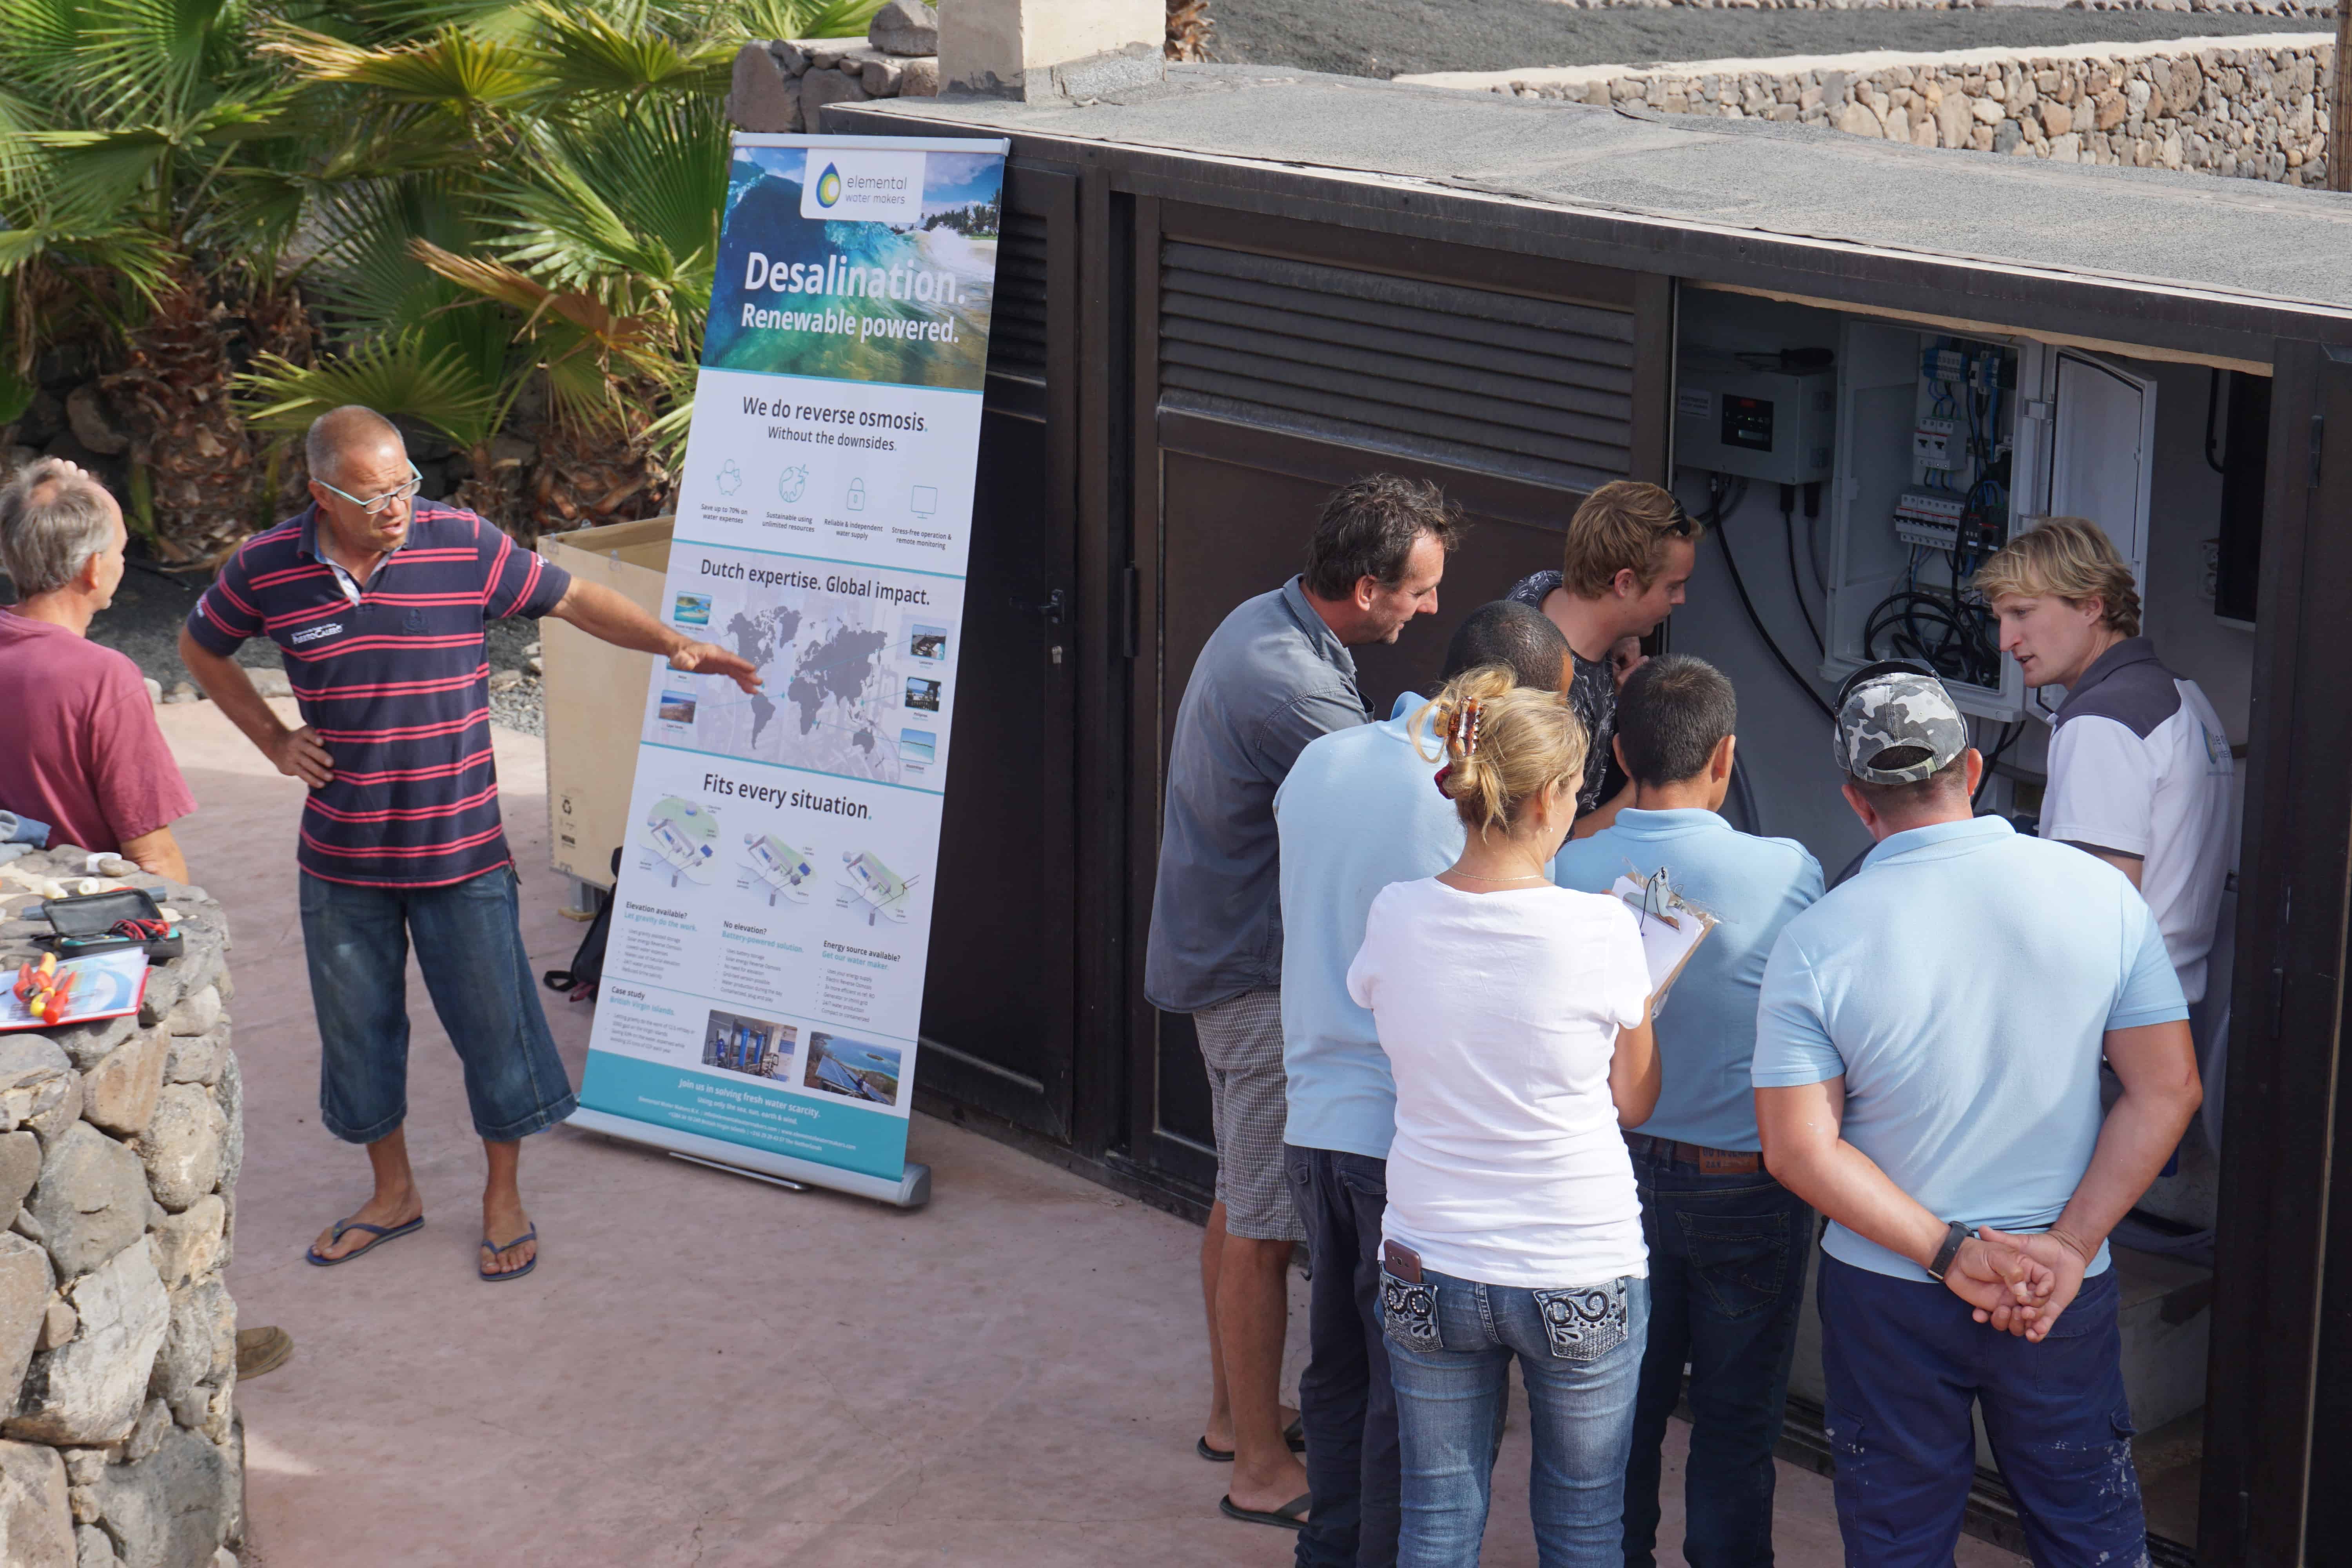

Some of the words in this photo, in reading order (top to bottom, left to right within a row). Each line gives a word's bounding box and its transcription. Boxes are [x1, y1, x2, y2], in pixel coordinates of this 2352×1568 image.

[847, 176, 907, 191] elemental
[846, 193, 870, 204] water
[873, 193, 906, 205] makers
[745, 251, 965, 304] Desalination.
[742, 303, 856, 336] Renewable
[860, 316, 959, 343] powered.
[744, 397, 766, 416] We
[772, 399, 790, 417] do
[796, 406, 854, 424] reverse
[860, 412, 928, 432] osmosis.
[768, 426, 812, 442] Without
[816, 431, 834, 444] the
[838, 433, 897, 451] downsides.
[766, 512, 796, 521] Sustainable
[850, 523, 882, 531] independent
[892, 527, 919, 535] Stress-free
[916, 541, 945, 550] monitoring
[701, 559, 744, 580] Dutch
[749, 567, 821, 591] expertise.
[826, 575, 870, 597] Global
[875, 581, 929, 606] impact.
[703, 773, 734, 795] Fits
[738, 781, 787, 809] every
[791, 789, 872, 820] situation.
[626, 901, 654, 912] Elevation
[656, 909, 687, 918] available?
[635, 913, 657, 925] gravity
[658, 917, 667, 925] do
[668, 919, 678, 928] the
[734, 923, 766, 934] elevation?
[777, 942, 804, 952] solution.
[822, 950, 834, 959] Get
[824, 940, 845, 952] Energy
[846, 946, 867, 955] source
[869, 951, 900, 961] available?
[612, 986, 626, 995] Case
[627, 991, 645, 1000] study
[678, 1079, 694, 1088] Join
[706, 1084, 713, 1093] in
[715, 1088, 741, 1100] solving
[743, 1093, 763, 1103] fresh
[765, 1100, 786, 1108] water
[789, 1105, 821, 1118] scarcity.
